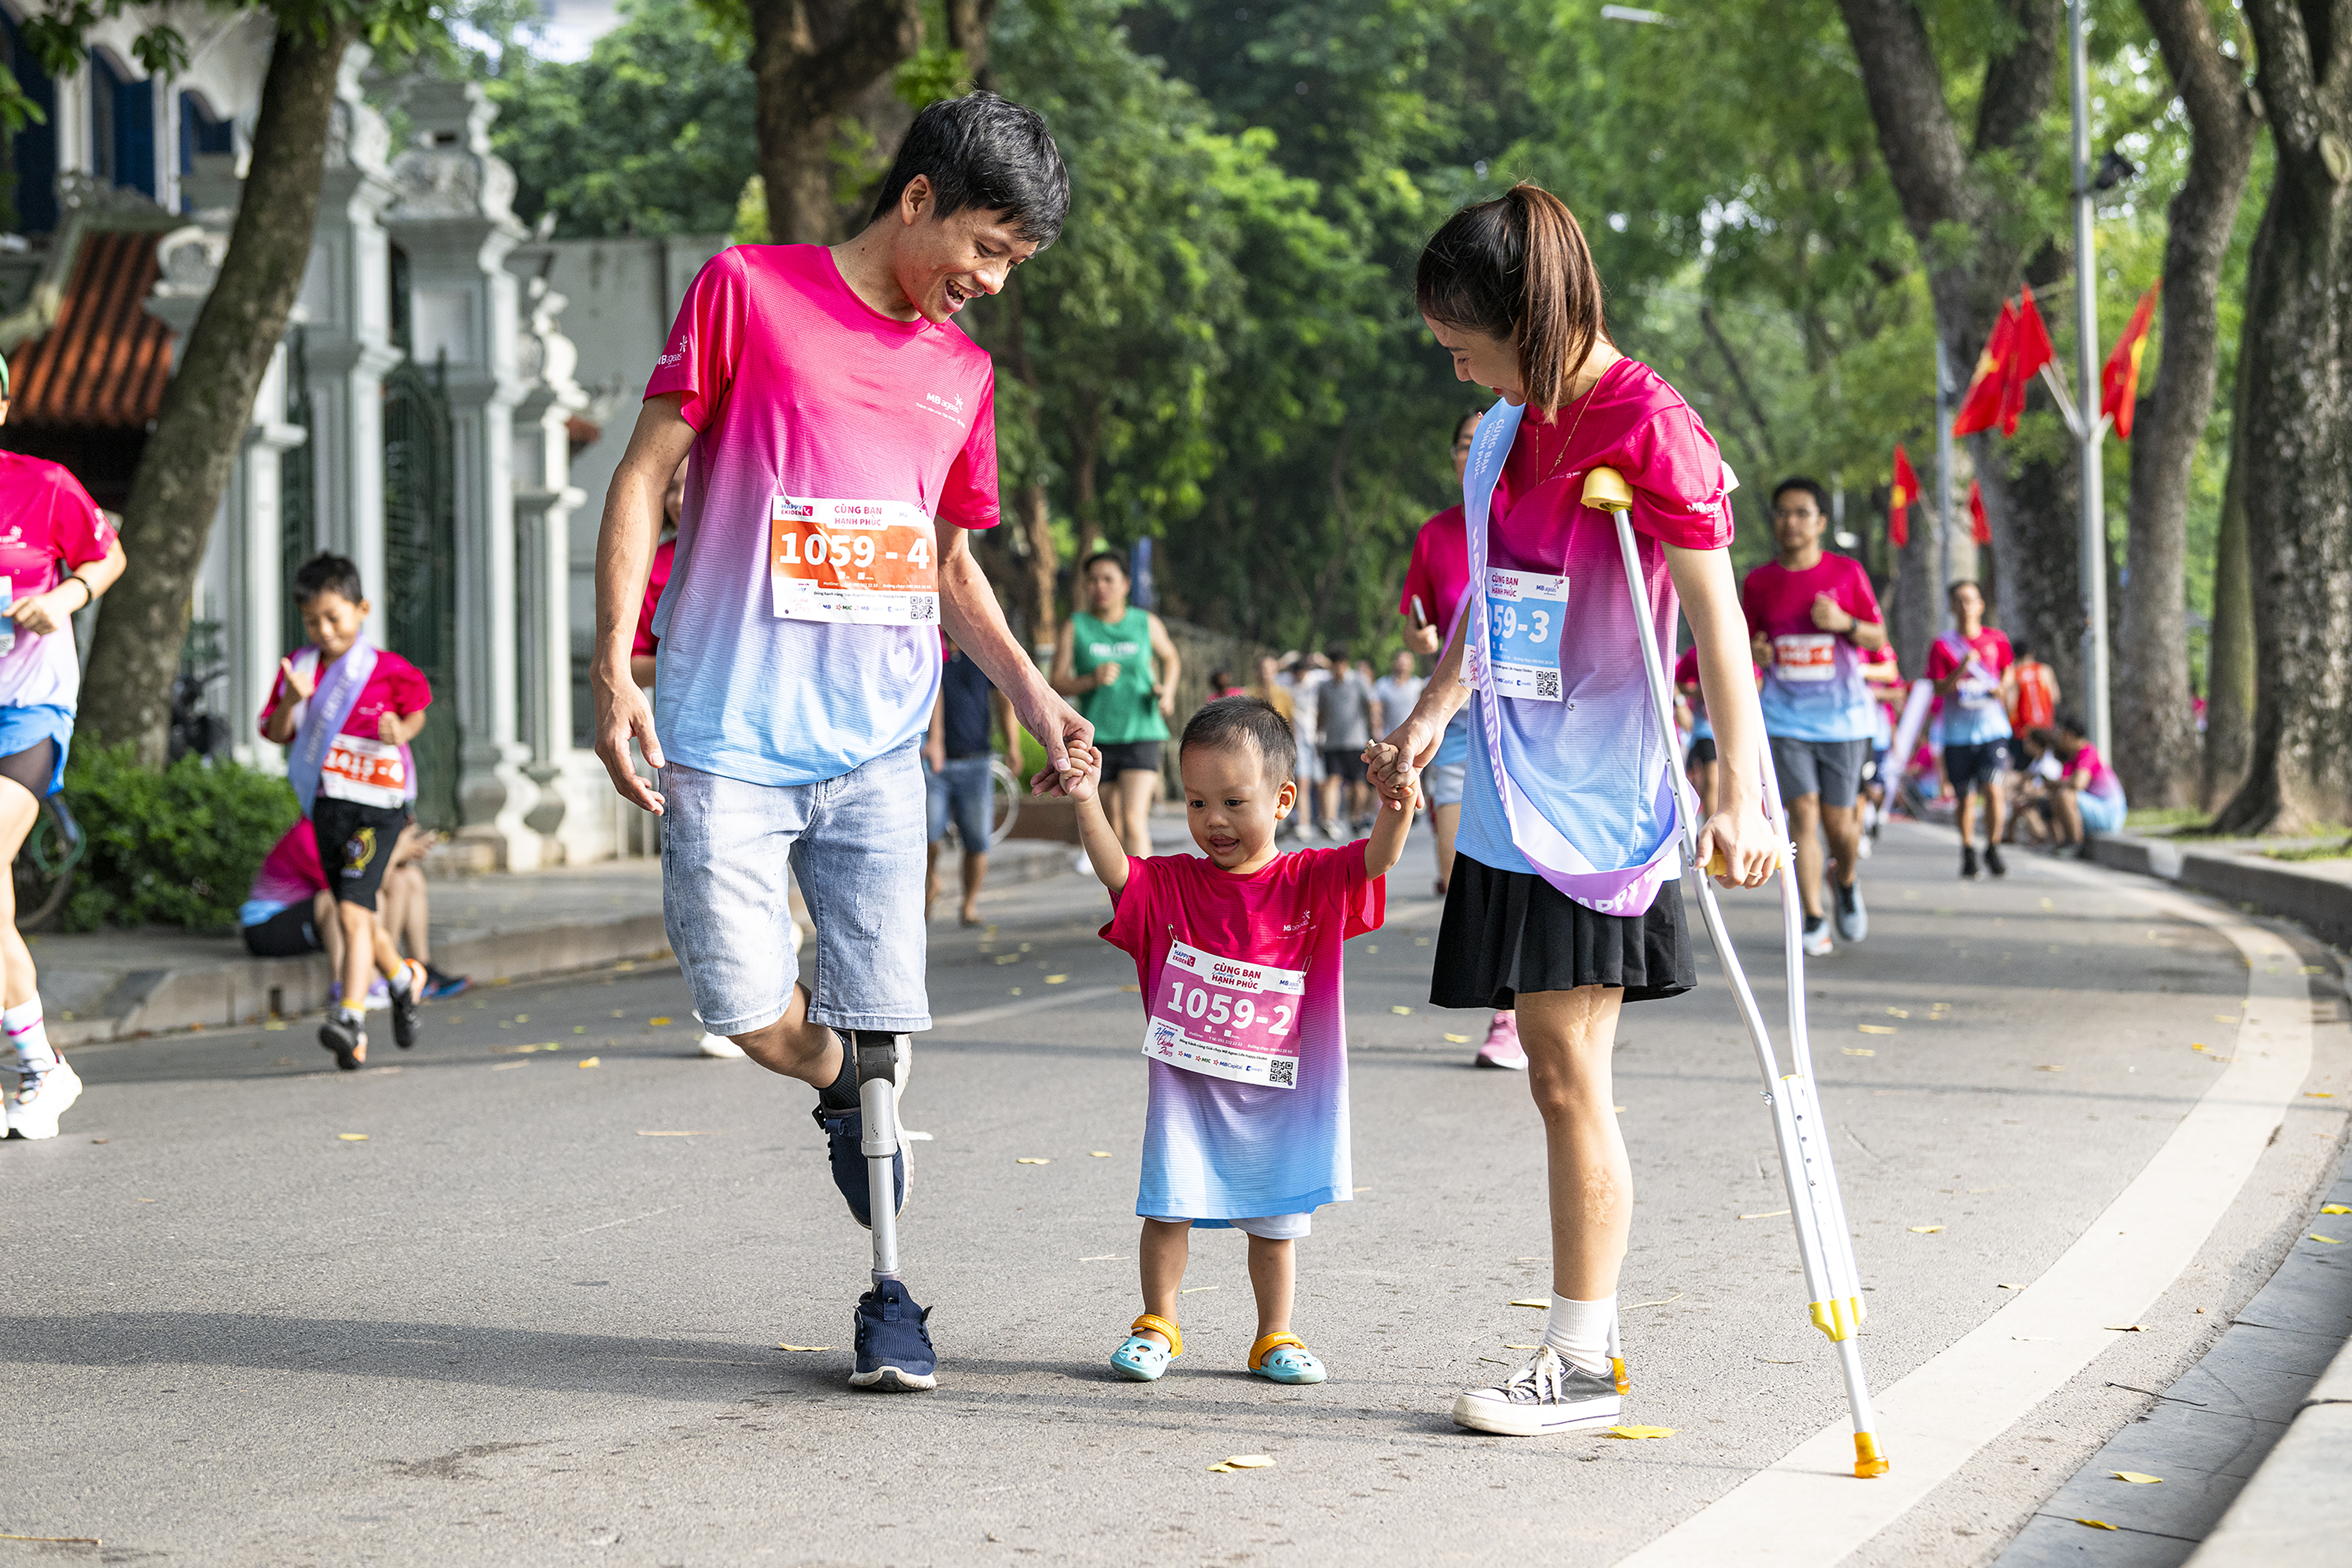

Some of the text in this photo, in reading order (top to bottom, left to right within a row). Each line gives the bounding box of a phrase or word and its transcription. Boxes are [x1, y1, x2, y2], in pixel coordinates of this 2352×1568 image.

[926, 393, 960, 414] MB ageas
[1479, 422, 1494, 449] HẠNH
[1488, 419, 1505, 449] CÙNG
[1474, 450, 1484, 479] PHÚC
[1480, 451, 1492, 474] BẠN
[834, 503, 882, 516] CÙNG BẠN
[835, 517, 881, 526] HẠNH PHÚC
[780, 532, 875, 567] 1059
[1473, 526, 1484, 625] HAPPY
[1492, 573, 1505, 584] CÙNG
[1506, 577, 1518, 587] BẠN
[1492, 587, 1517, 597] HẠNH PHÚC
[1477, 633, 1496, 746] EKIDEN
[1173, 955, 1188, 965] EKIDEN
[1174, 949, 1189, 959] HAPPY
[1212, 974, 1259, 989] HẠNH PHÚC
[1213, 962, 1261, 980] CÙNG BẠN
[1167, 981, 1291, 1036] 1059-2
